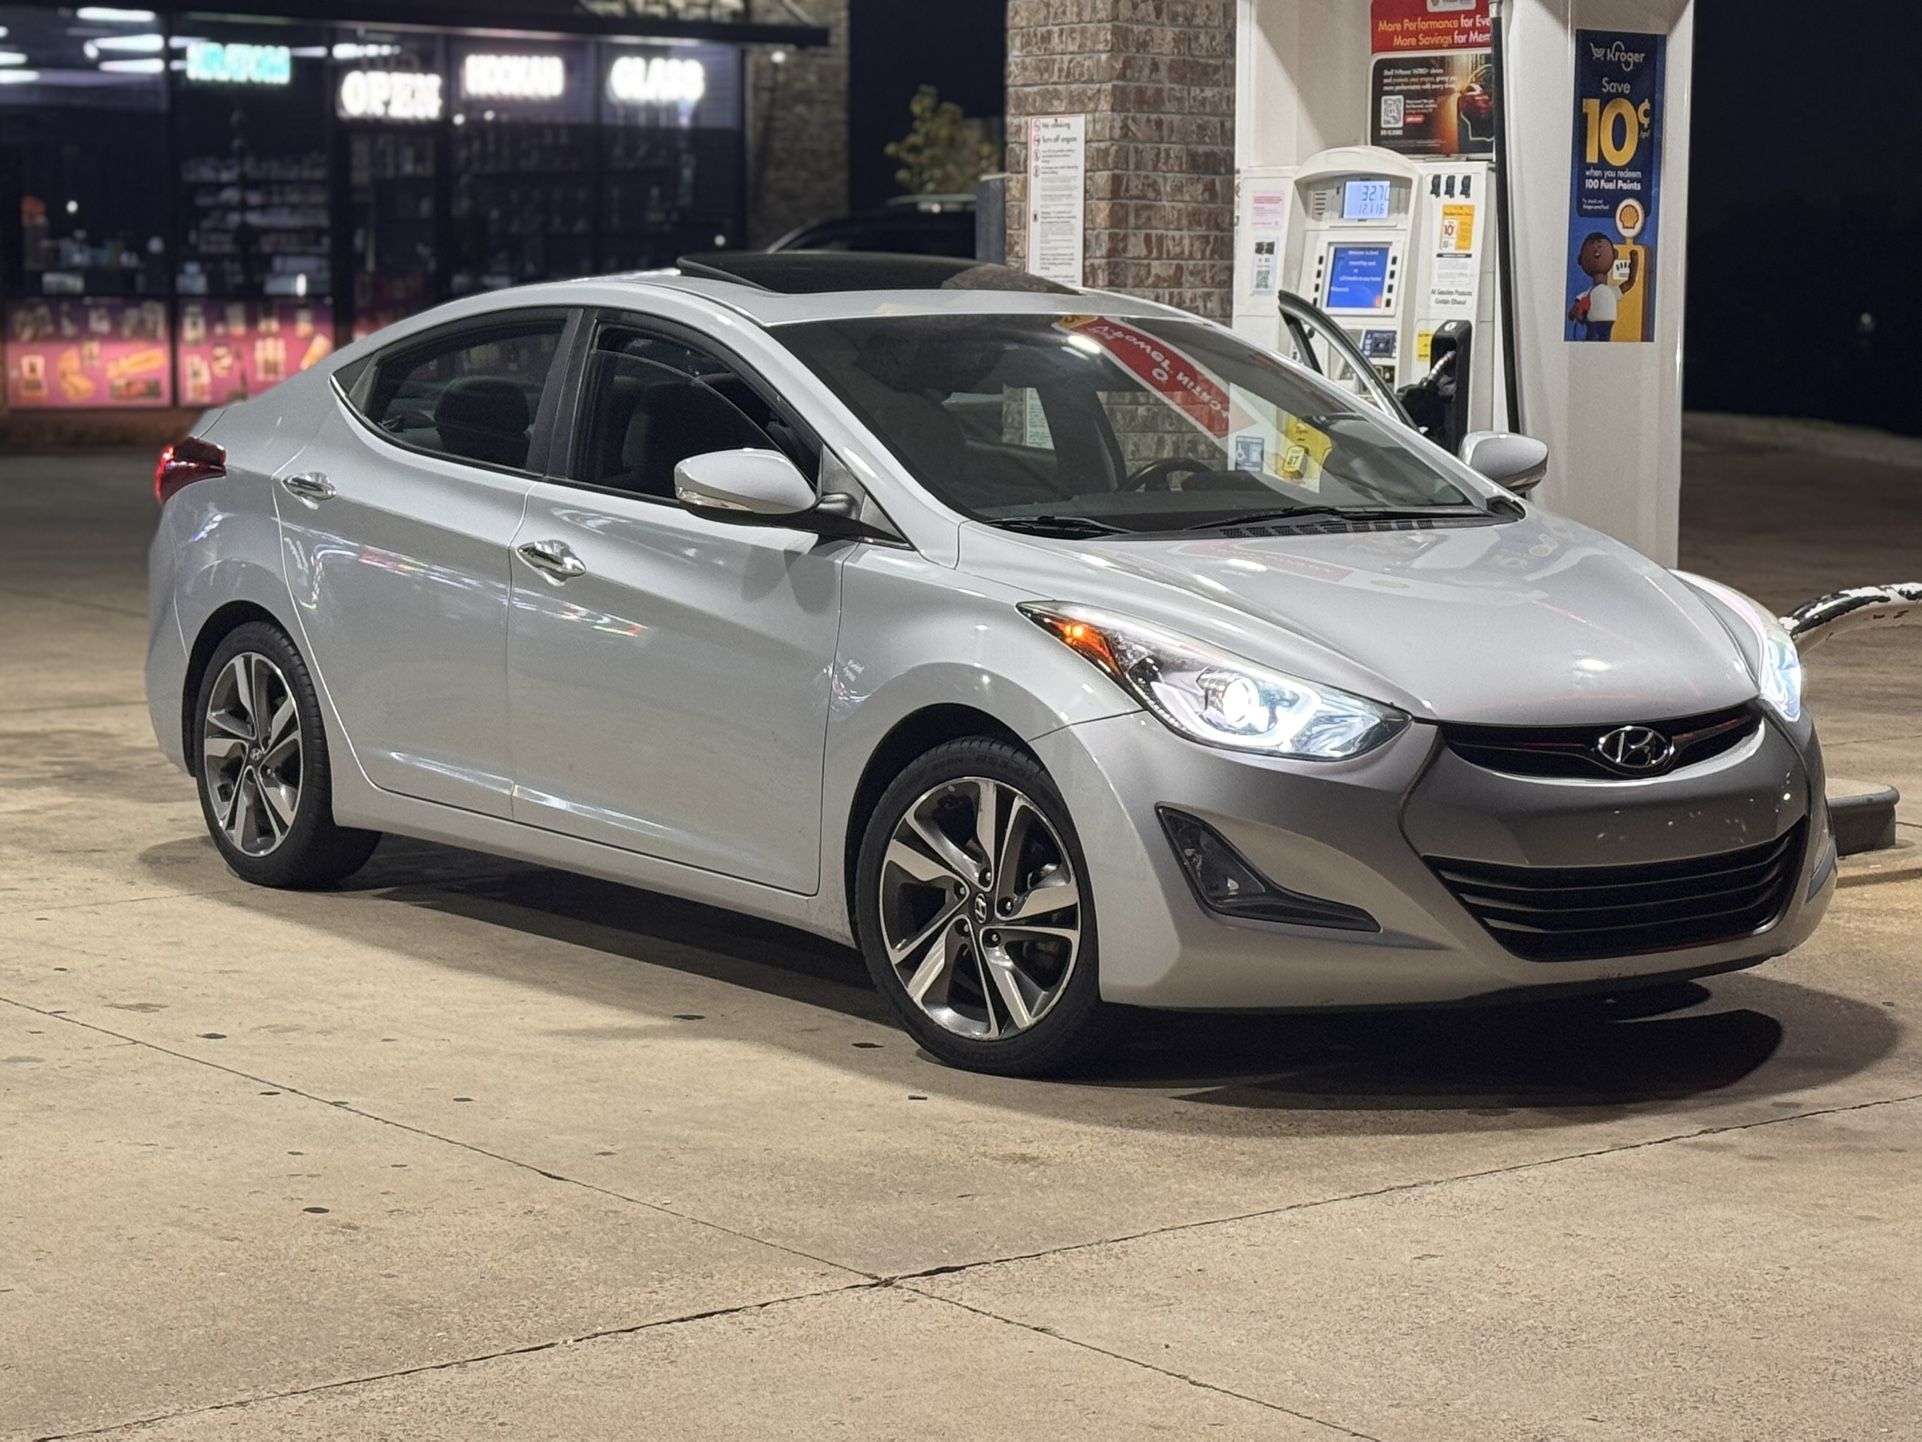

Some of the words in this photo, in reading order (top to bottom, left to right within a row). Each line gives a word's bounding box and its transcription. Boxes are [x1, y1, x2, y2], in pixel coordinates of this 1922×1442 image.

[1378, 20, 1401, 32] More
[1403, 16, 1459, 30] Performance
[1460, 14, 1473, 28] for
[1393, 34, 1417, 46] More
[1418, 33, 1452, 47] Savings
[1454, 30, 1467, 43] for
[1606, 41, 1646, 72] Kroger
[610, 56, 706, 101] GLASS
[1601, 77, 1631, 94] Save
[341, 70, 443, 119] OPEN
[1585, 166, 1602, 177] when
[1604, 170, 1616, 179] you
[1617, 168, 1642, 178] redeem
[1585, 178, 1599, 189] 100
[1600, 179, 1616, 190] Fuel
[1617, 180, 1641, 190] Points
